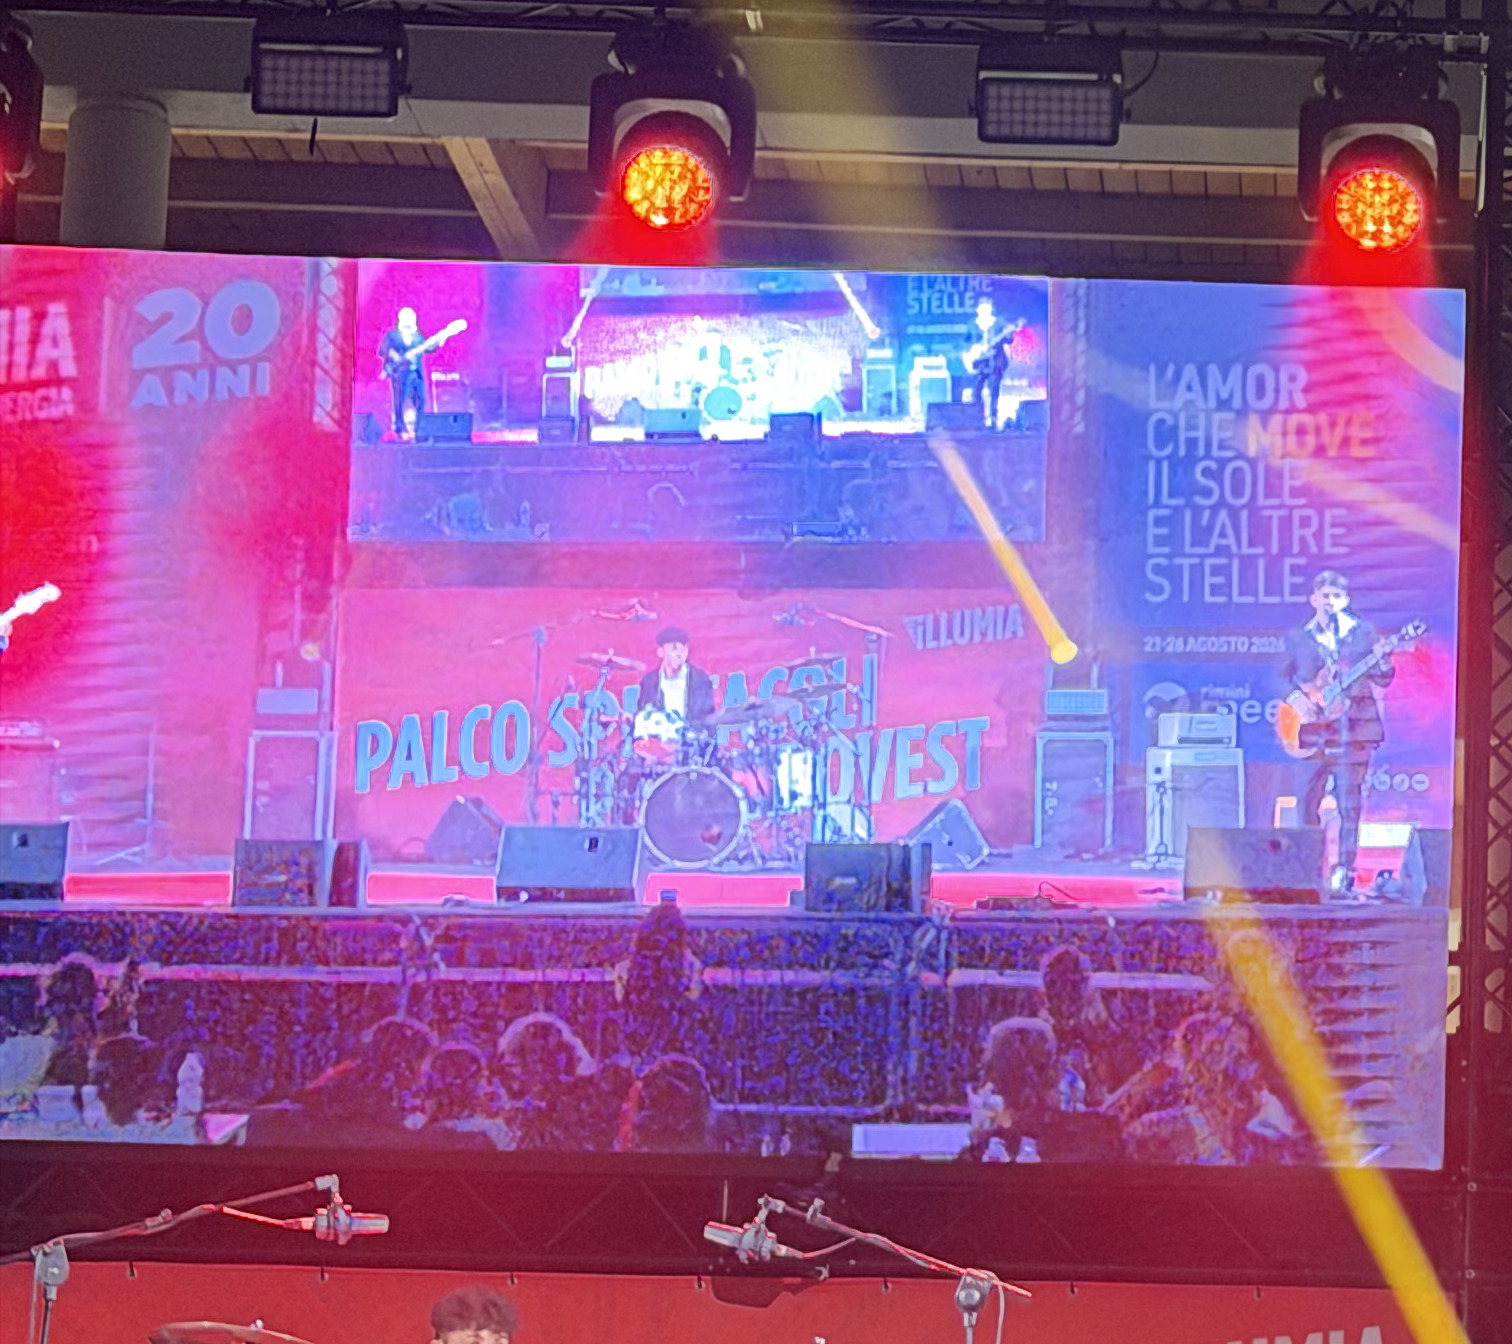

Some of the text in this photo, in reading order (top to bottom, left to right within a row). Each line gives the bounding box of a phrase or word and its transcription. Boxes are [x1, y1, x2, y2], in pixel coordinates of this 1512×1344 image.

[130, 278, 282, 370] 20
[906, 292, 977, 315] STELLE
[130, 361, 271, 411] ANNI
[1148, 361, 1308, 411] L'AMOR
[1146, 410, 1378, 461] CHE MOVE
[1148, 459, 1308, 507] IL SOLE
[1147, 507, 1351, 556] E L'ALTRE
[1144, 556, 1308, 604] STELLE
[354, 698, 532, 793] PALCO
